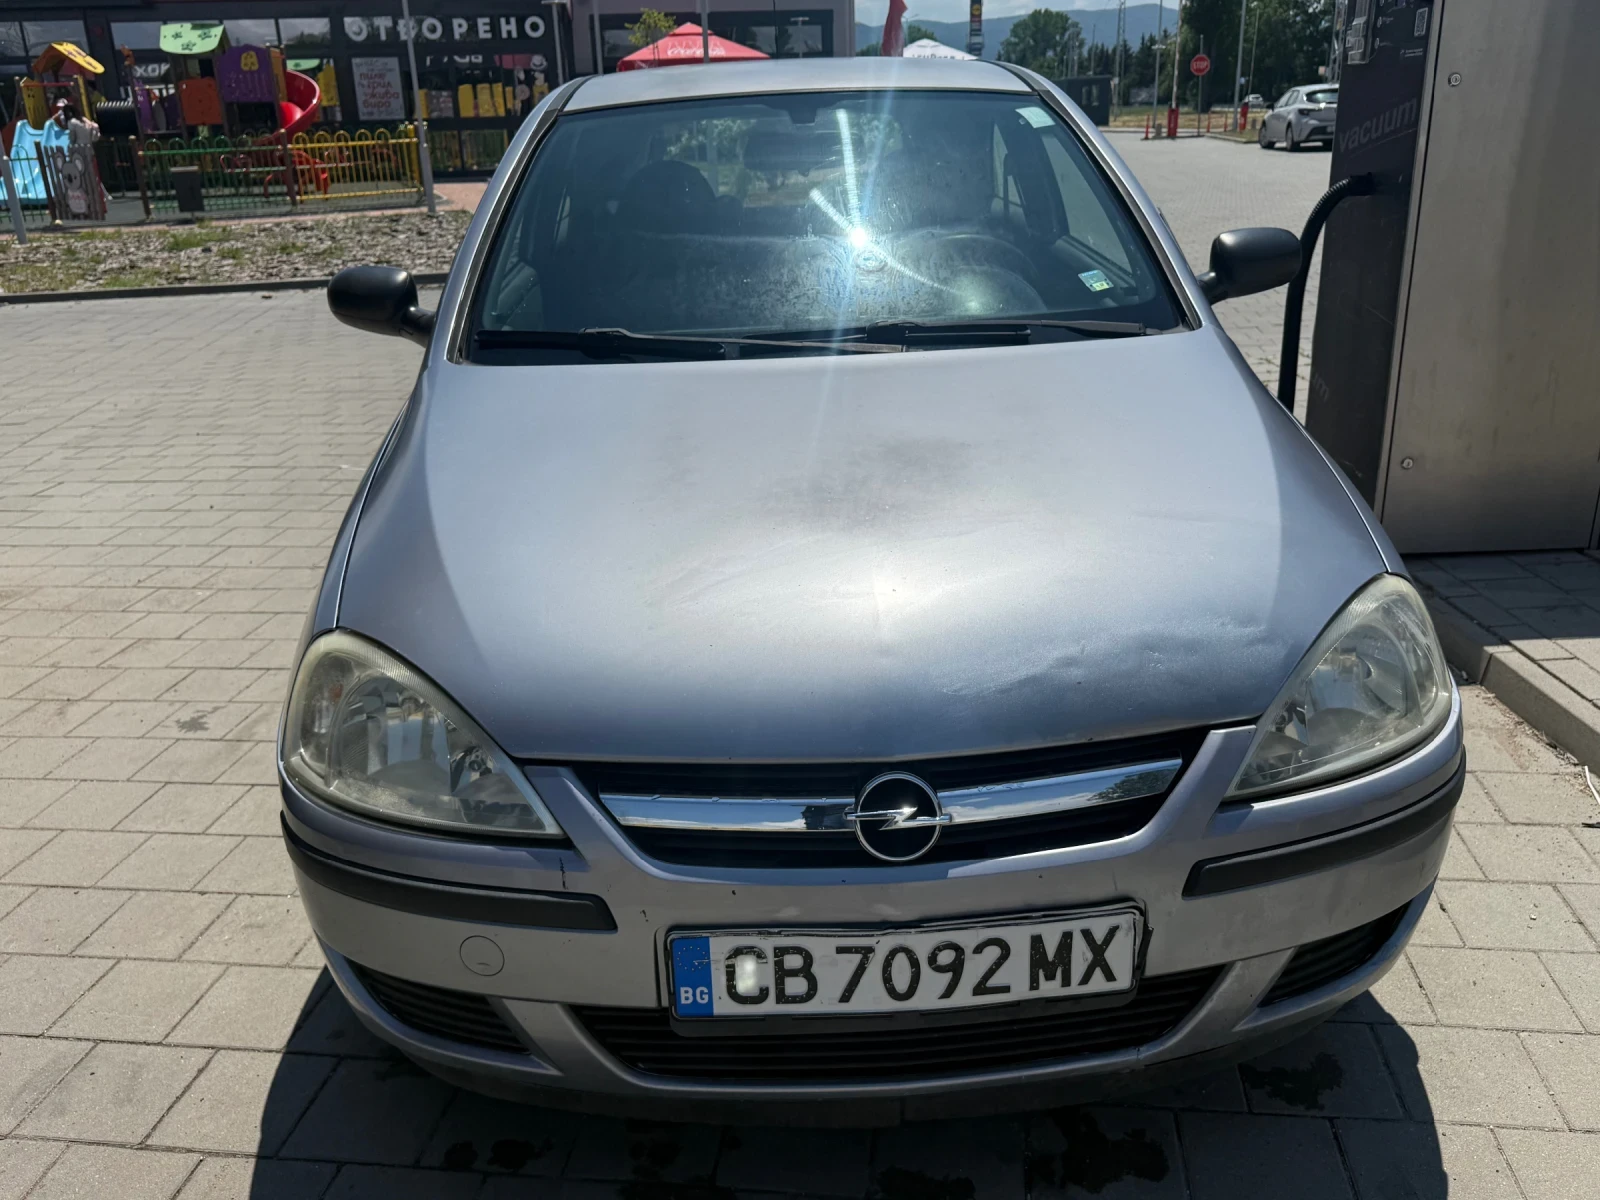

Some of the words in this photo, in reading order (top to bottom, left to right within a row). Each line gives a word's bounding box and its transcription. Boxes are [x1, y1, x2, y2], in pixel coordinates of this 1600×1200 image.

[343, 15, 545, 41] ОТВОРЕНО
[1193, 61, 1208, 70] STOP
[1339, 97, 1417, 153] vacuum
[680, 985, 709, 1004] BG
[835, 937, 1012, 1003] 7092
